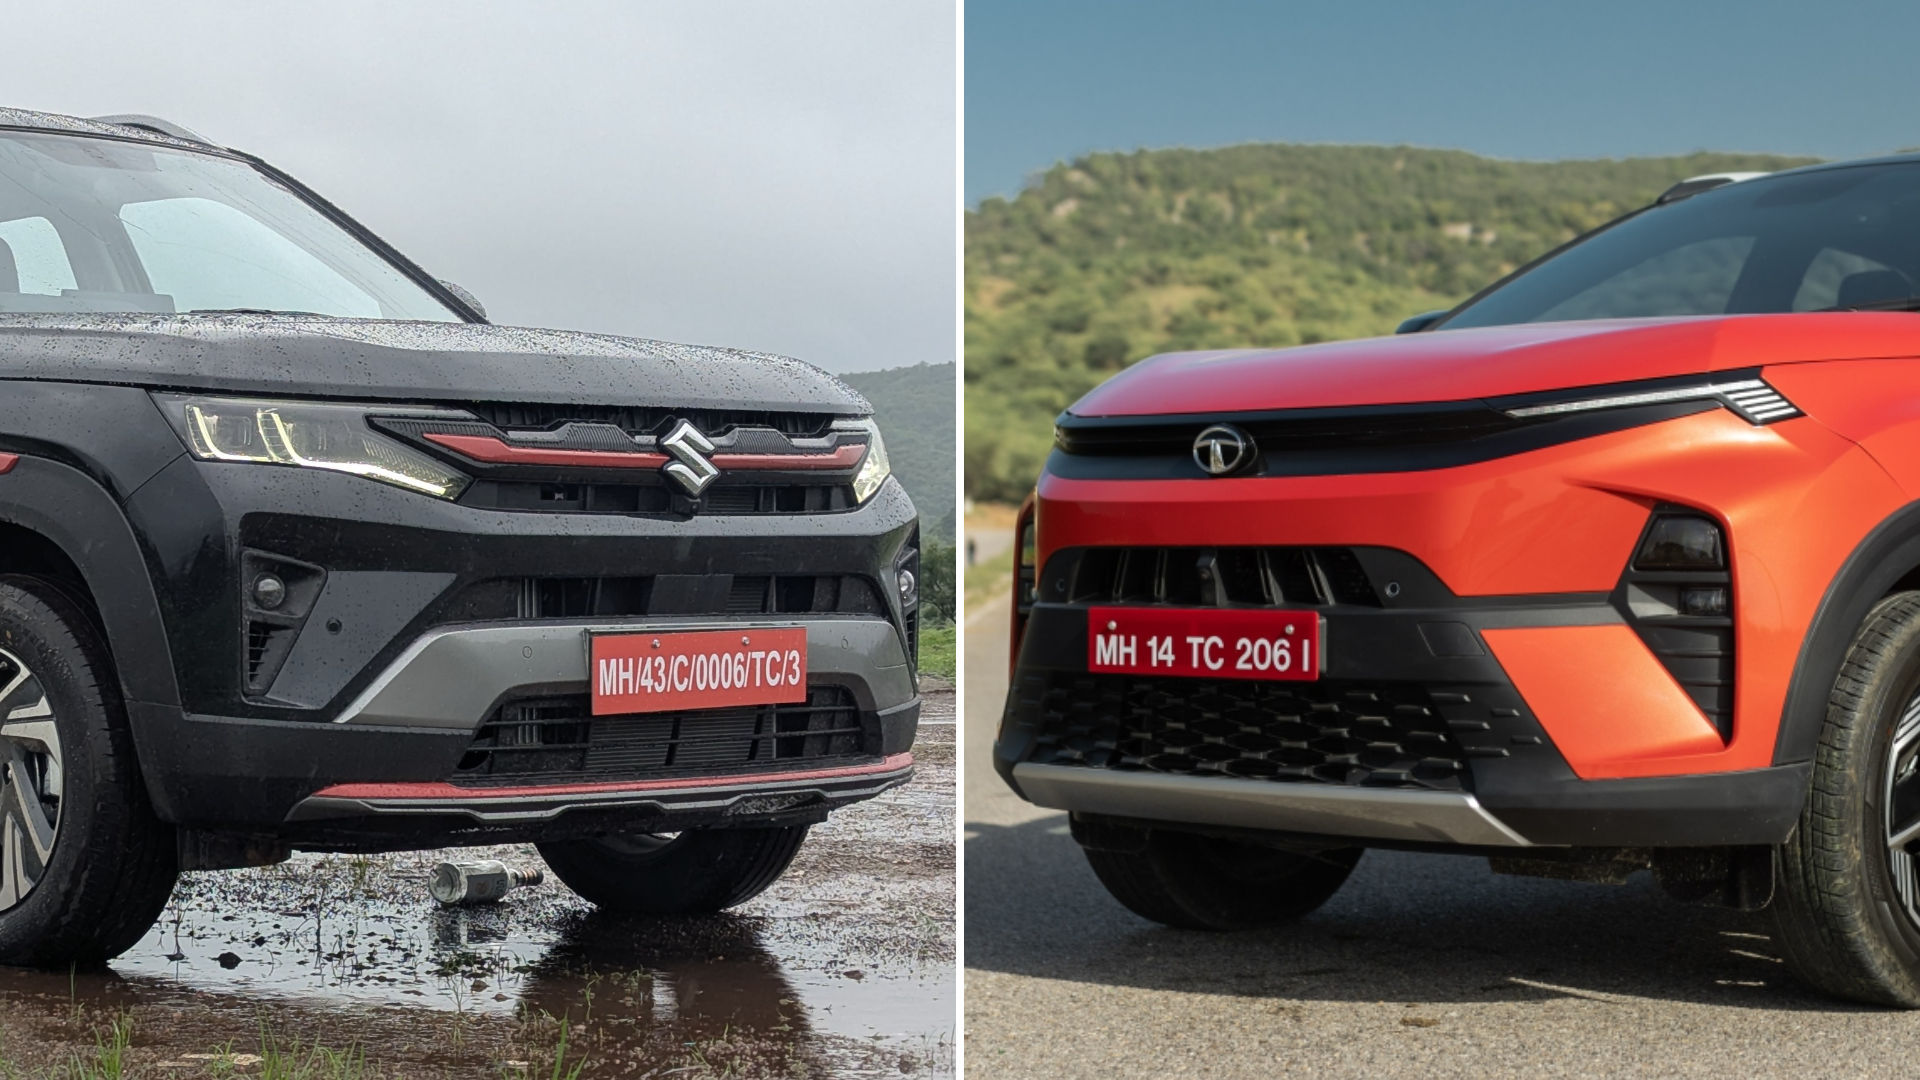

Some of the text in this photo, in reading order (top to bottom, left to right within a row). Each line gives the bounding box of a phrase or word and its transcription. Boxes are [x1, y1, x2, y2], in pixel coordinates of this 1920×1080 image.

[1096, 634, 1137, 666] MH
[1146, 635, 1175, 668] 14
[1186, 636, 1224, 670] TC
[599, 650, 800, 696] MH/43/C/0006/TC/3
